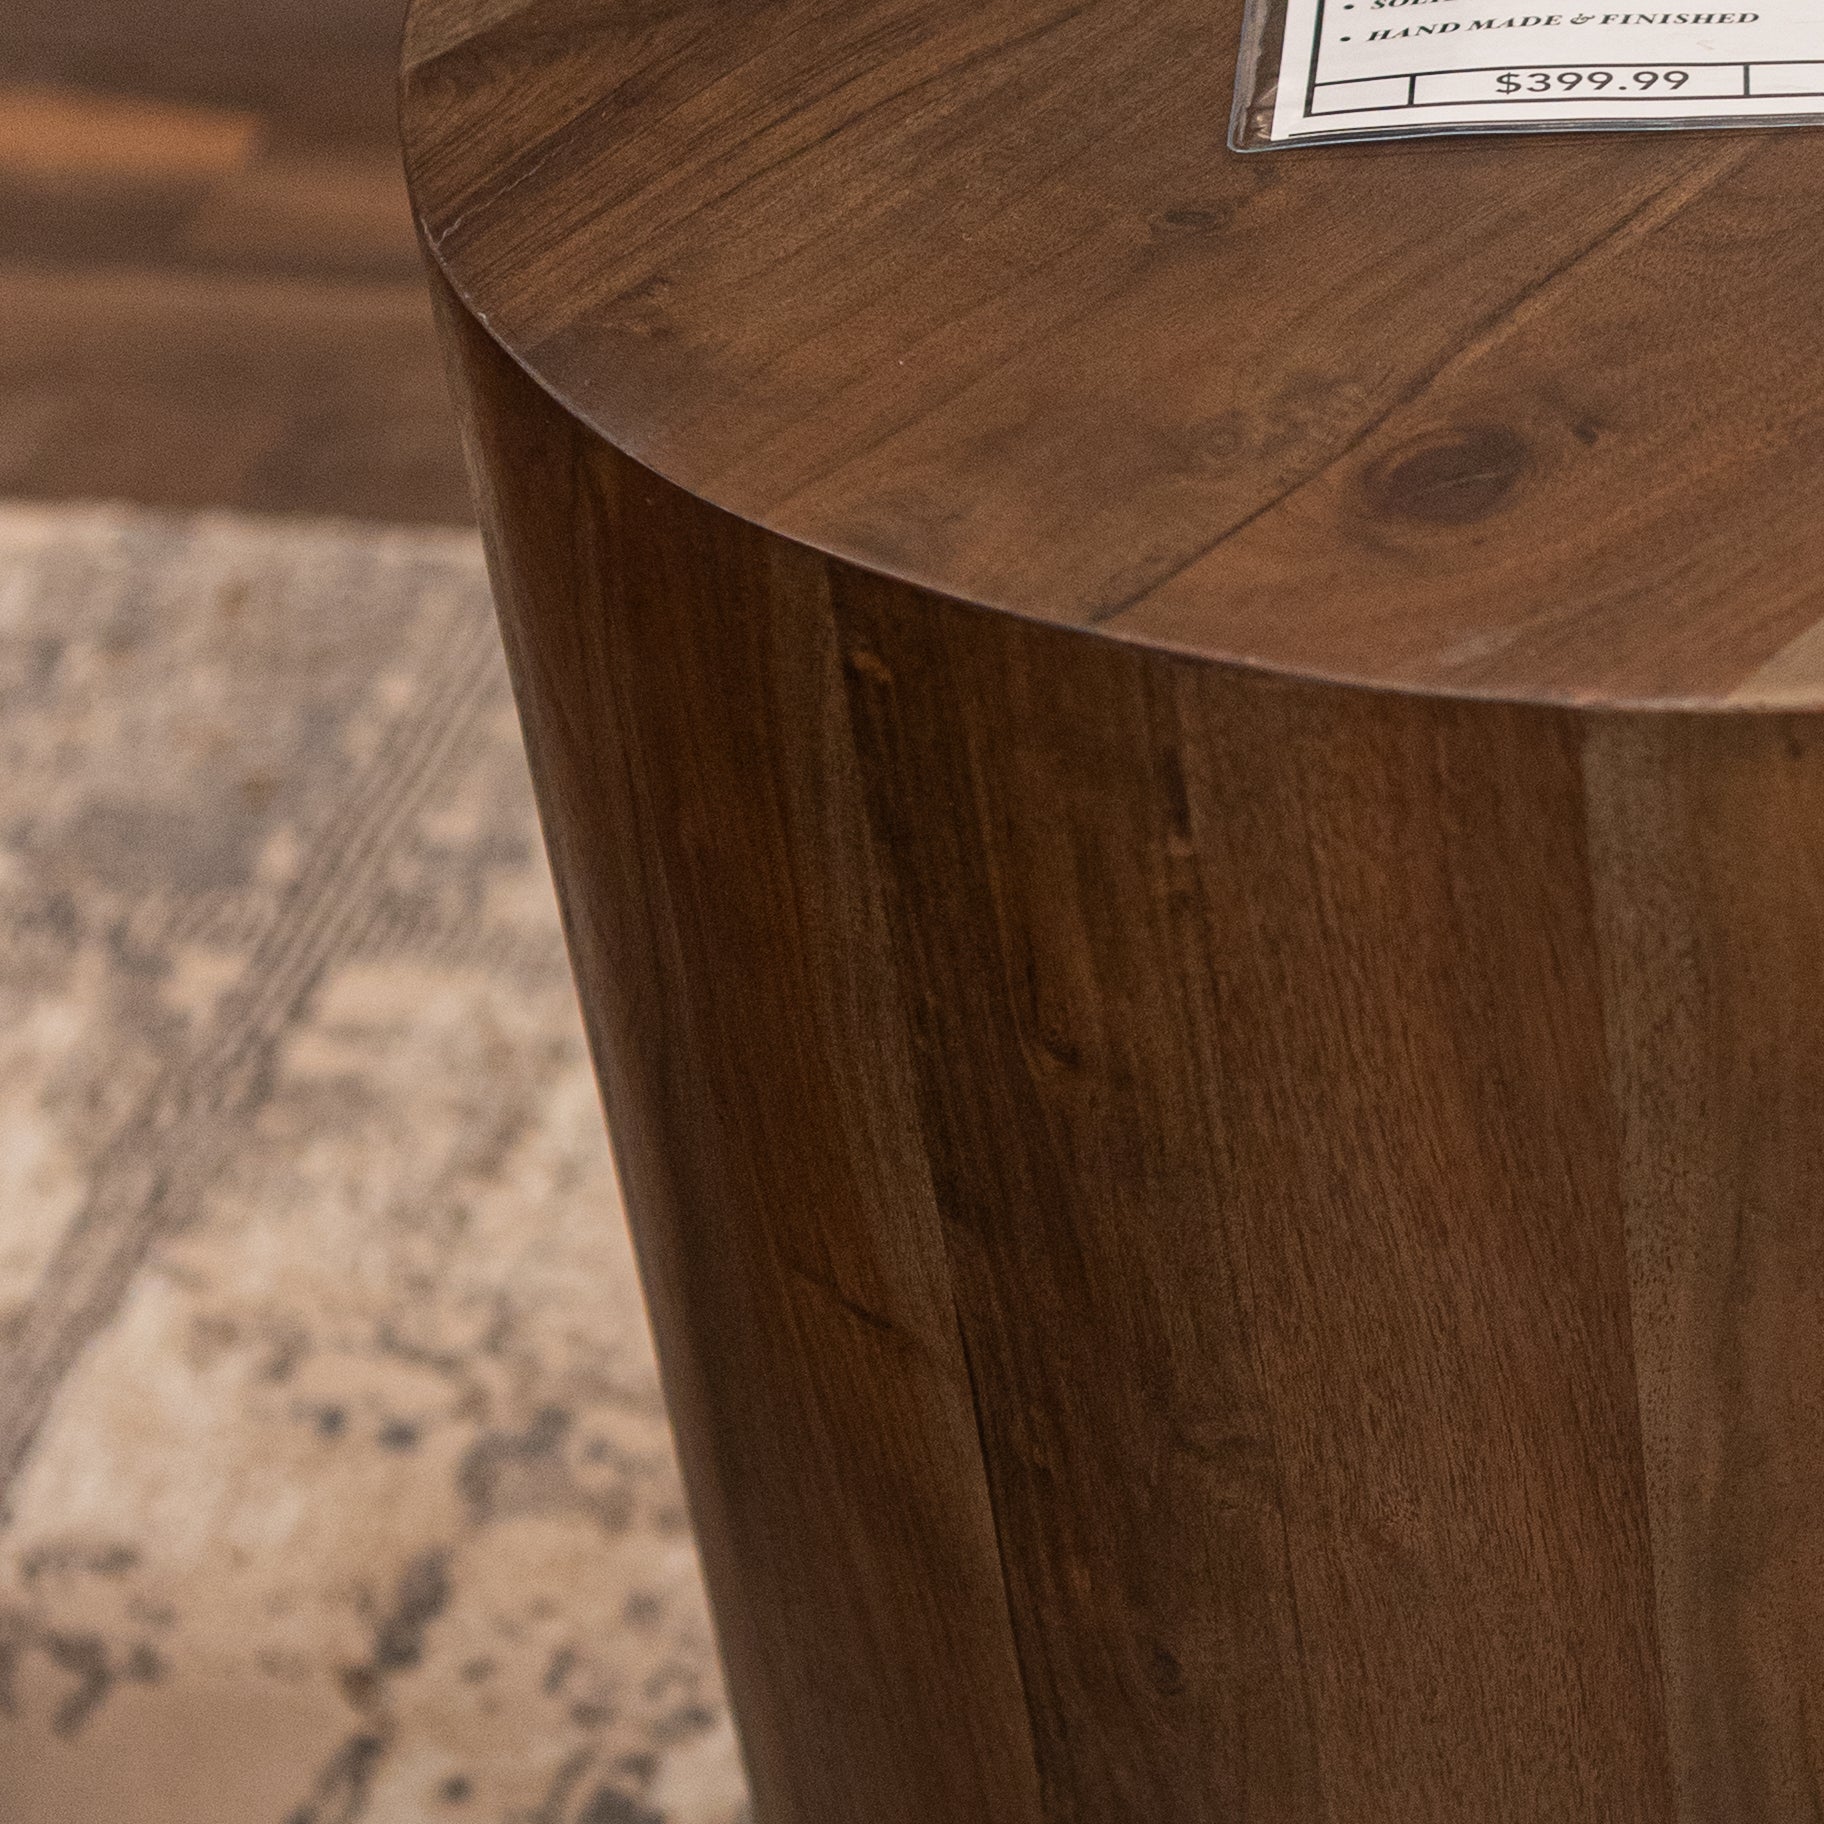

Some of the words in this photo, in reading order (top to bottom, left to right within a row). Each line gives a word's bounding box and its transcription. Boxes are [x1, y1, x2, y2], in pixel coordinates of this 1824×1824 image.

[1366, 22, 1461, 42] HAND
[1466, 14, 1564, 32] MADE
[1570, 12, 1597, 25] &
[1600, 12, 1760, 25] FINISHED
[1495, 70, 1690, 95] $399.99
